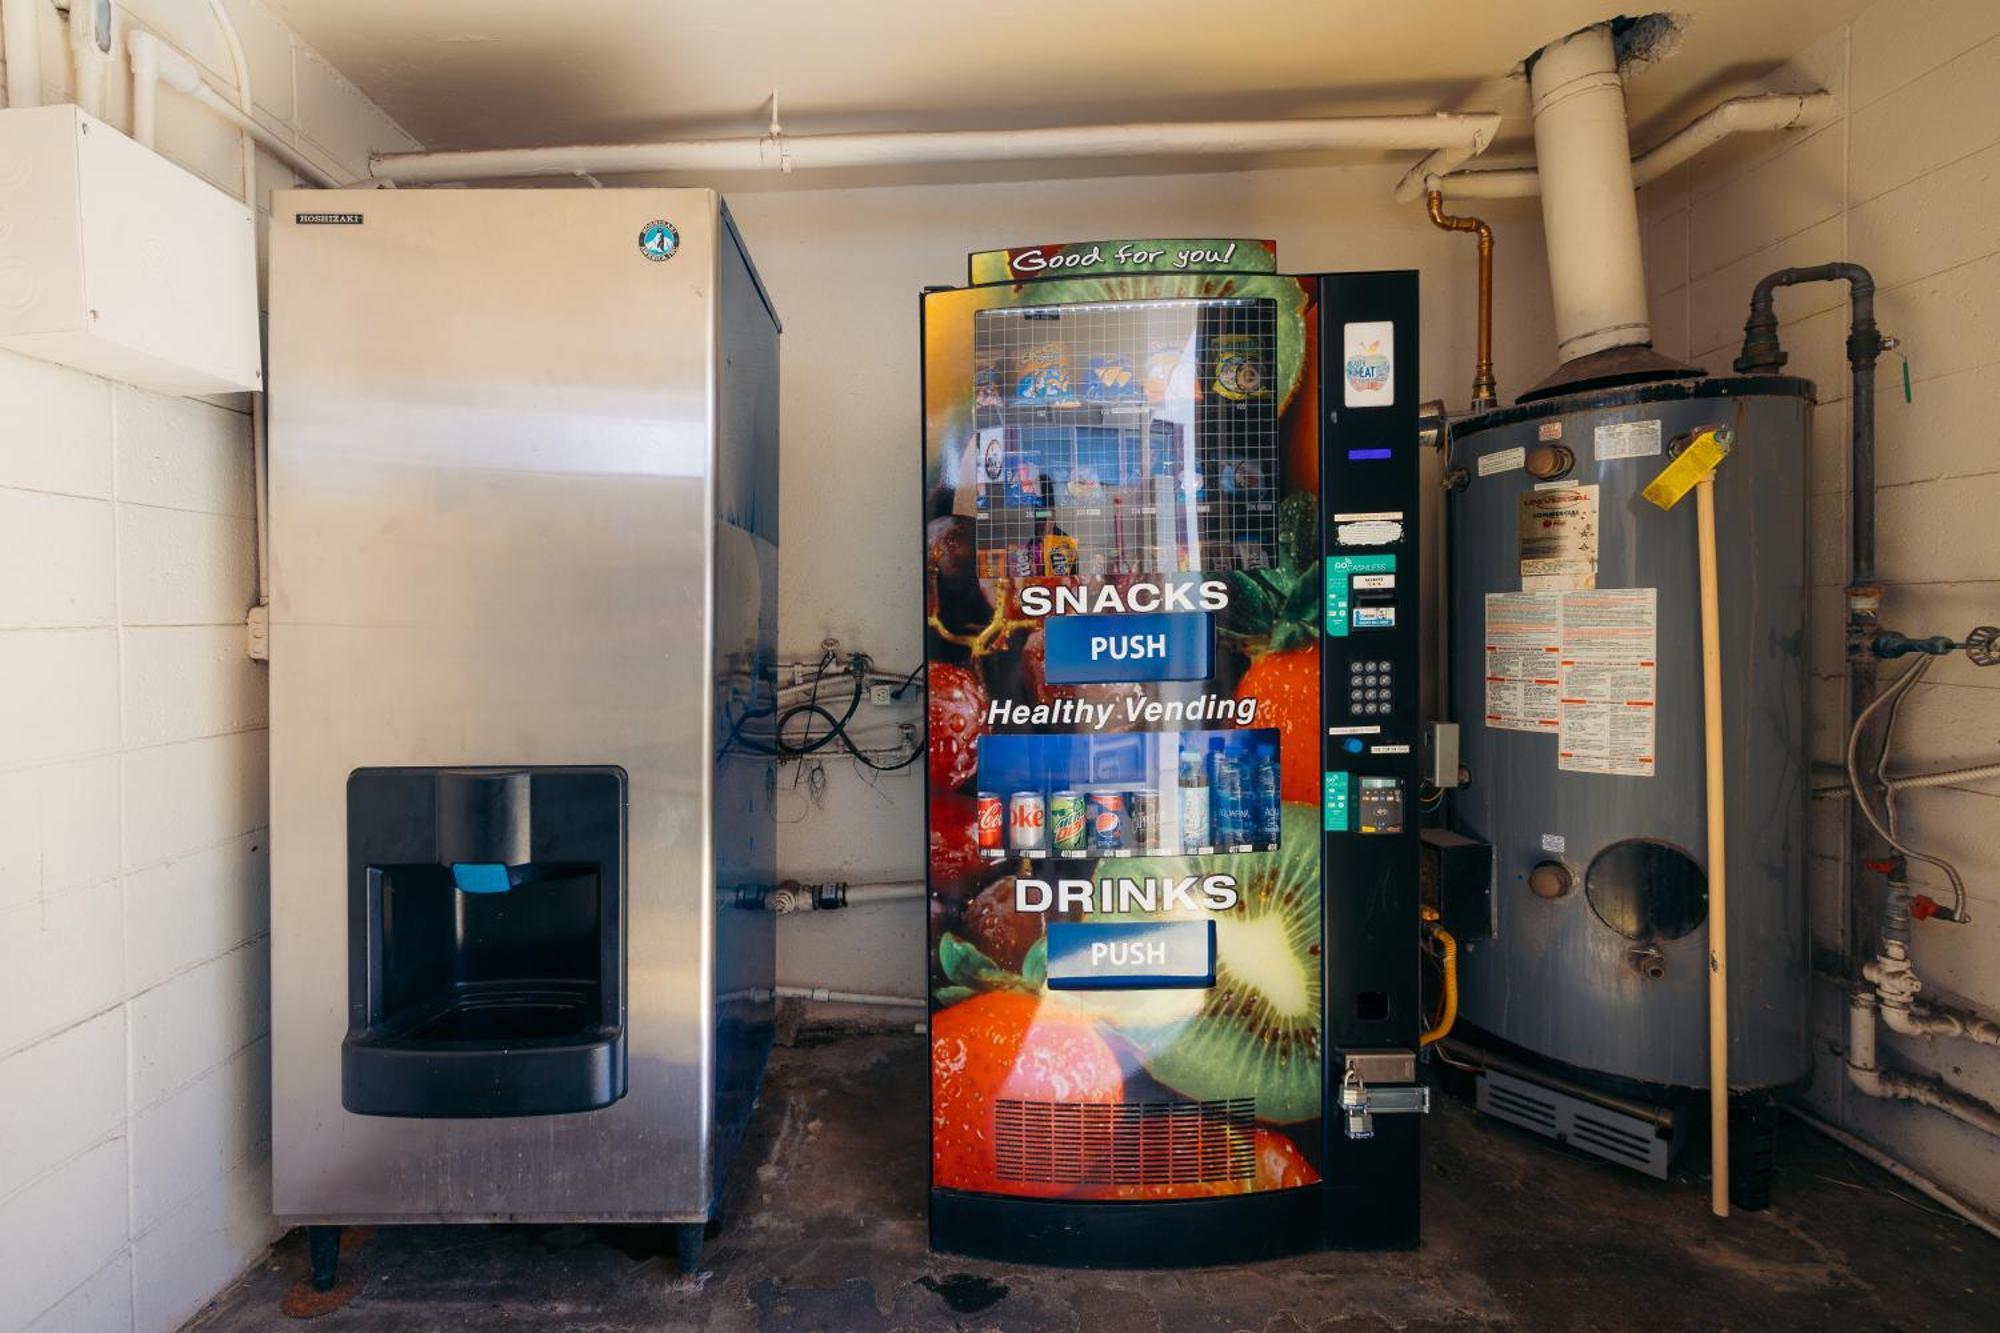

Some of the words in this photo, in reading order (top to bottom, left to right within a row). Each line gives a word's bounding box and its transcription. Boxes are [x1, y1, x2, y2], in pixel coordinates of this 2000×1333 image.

[299, 214, 360, 223] HOSHIZAKI
[1012, 246, 1104, 272] Good
[1114, 245, 1166, 265] for
[1173, 242, 1236, 268] you!
[1021, 580, 1229, 616] SNACKS
[1091, 633, 1166, 661] PUSH
[986, 697, 1115, 730] Healthy
[1124, 694, 1257, 725] Vending
[1010, 804, 1044, 828] oke
[1014, 872, 1238, 914] DRINKS
[1091, 941, 1166, 966] PUSH
